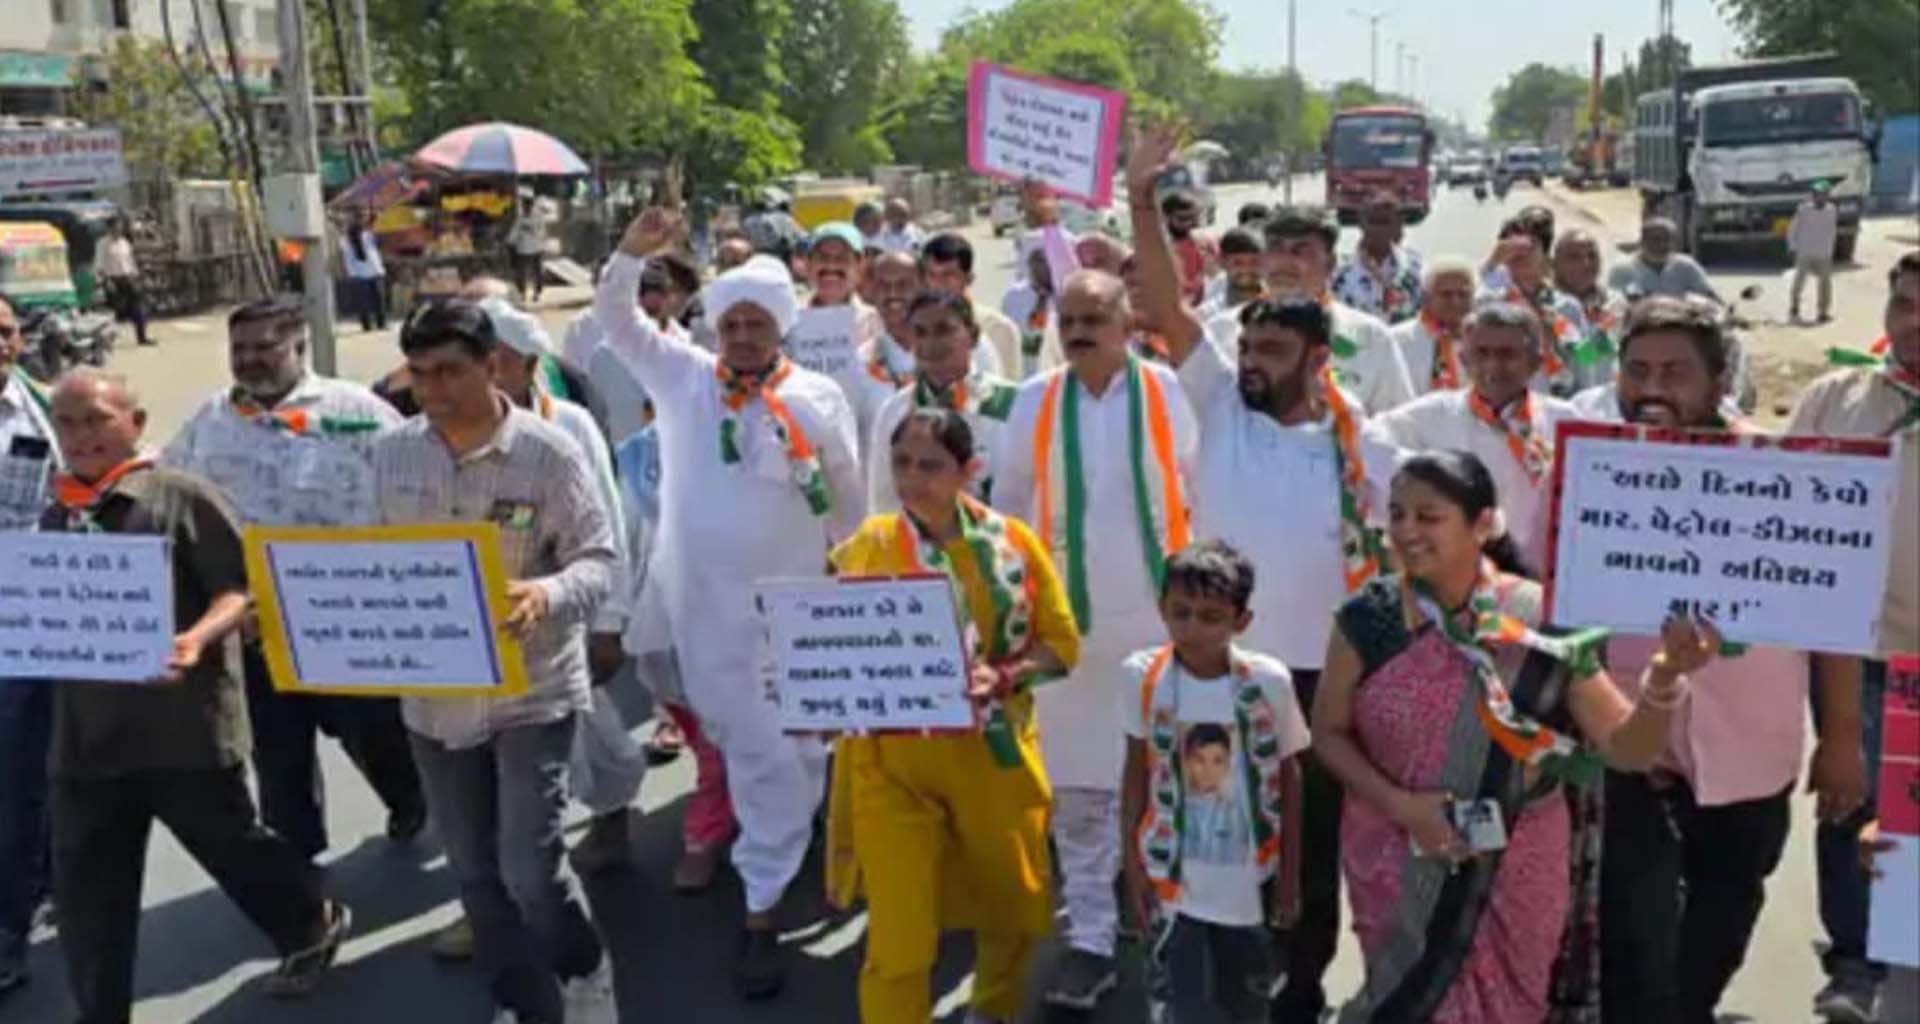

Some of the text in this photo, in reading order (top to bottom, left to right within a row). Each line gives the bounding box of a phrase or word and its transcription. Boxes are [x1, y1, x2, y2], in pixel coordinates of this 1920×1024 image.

[1701, 468, 1792, 500] દિનનો
[1807, 476, 1868, 507] કેવો
[1578, 508, 1640, 530] માર.
[1603, 550, 1839, 588] ભાવનો અતિશય
